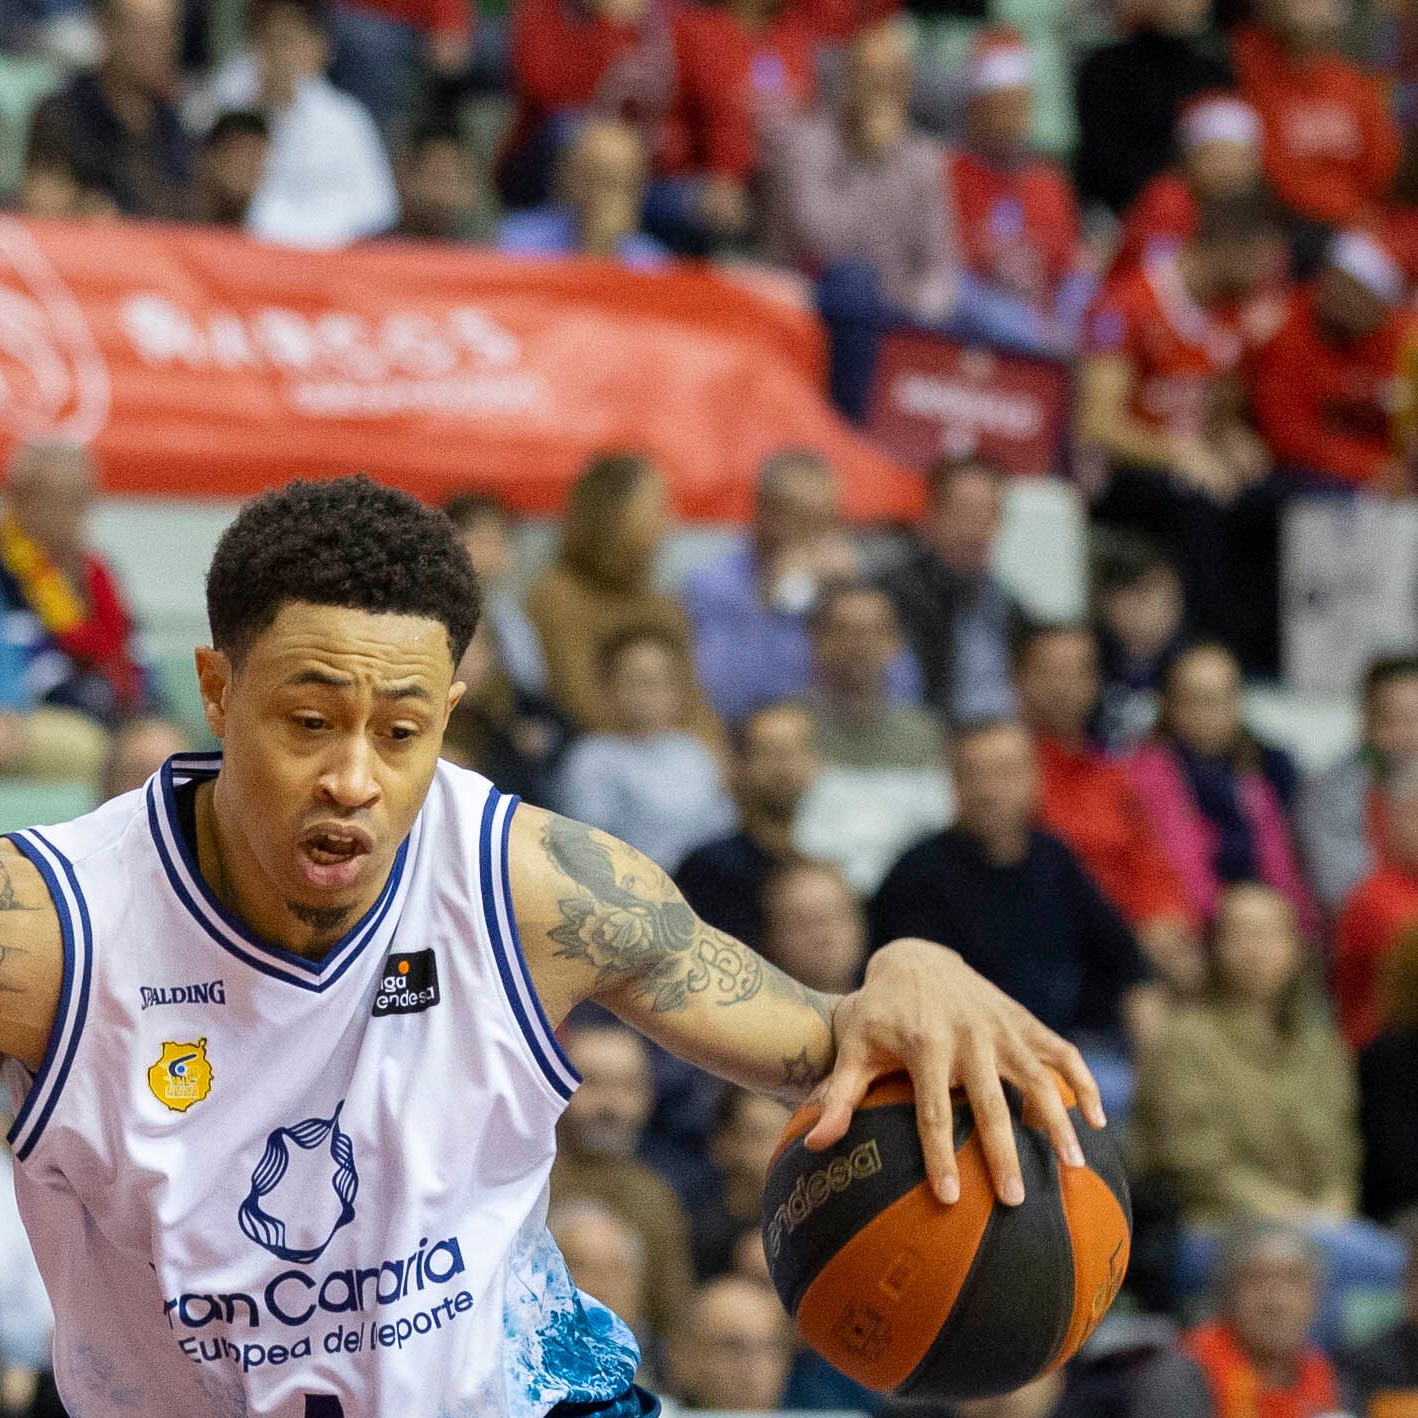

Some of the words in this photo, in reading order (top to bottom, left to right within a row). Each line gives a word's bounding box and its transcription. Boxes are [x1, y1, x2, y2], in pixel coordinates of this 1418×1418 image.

[139, 979, 227, 1011] SPALDING
[376, 986, 435, 1010] endesa
[380, 975, 407, 993] iga
[162, 1292, 260, 1328] ran
